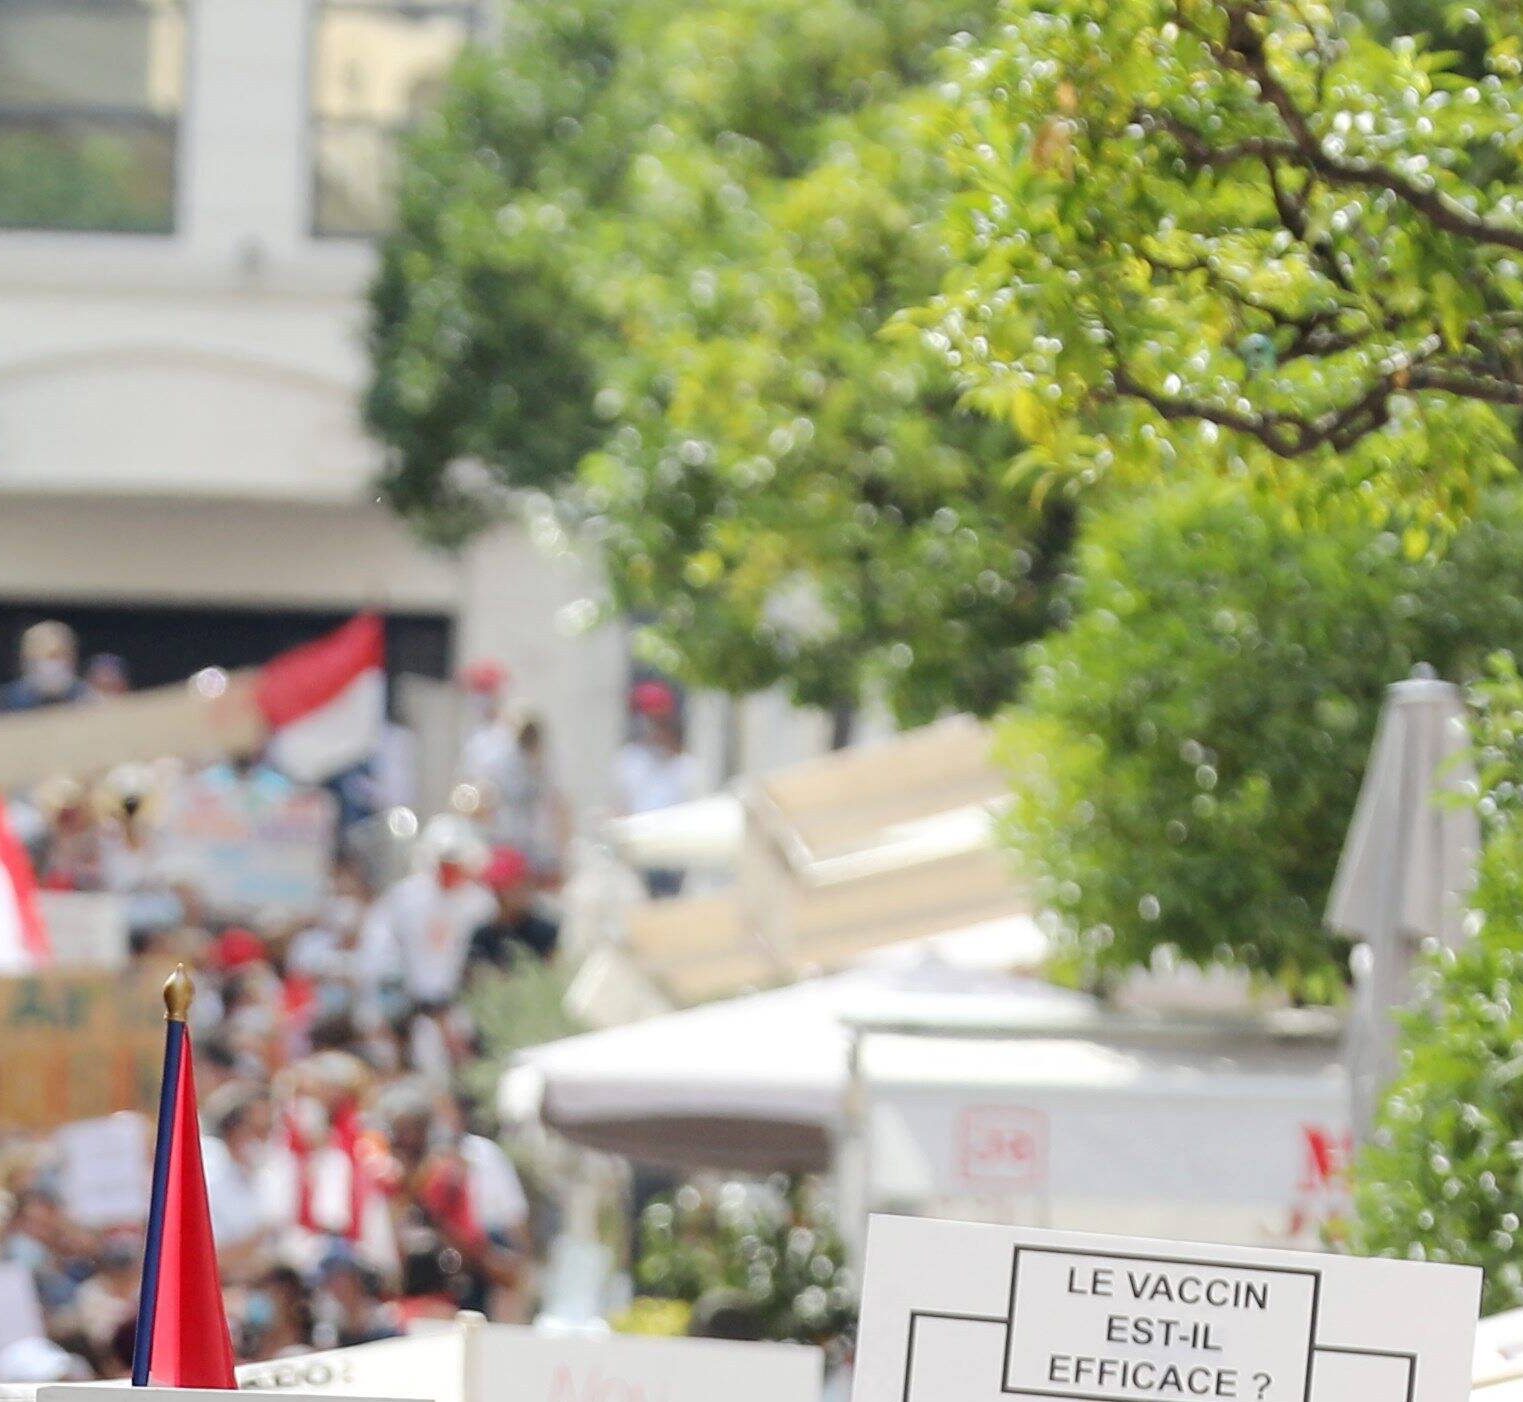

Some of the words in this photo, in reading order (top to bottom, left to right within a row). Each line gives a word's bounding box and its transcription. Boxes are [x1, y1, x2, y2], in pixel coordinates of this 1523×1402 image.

[1067, 1267, 1114, 1296] LE
[1127, 1271, 1269, 1310] VACCIN
[1106, 1315, 1222, 1352] EST-IL
[1048, 1355, 1238, 1399] EFFICACE
[1253, 1373, 1272, 1400] ?
